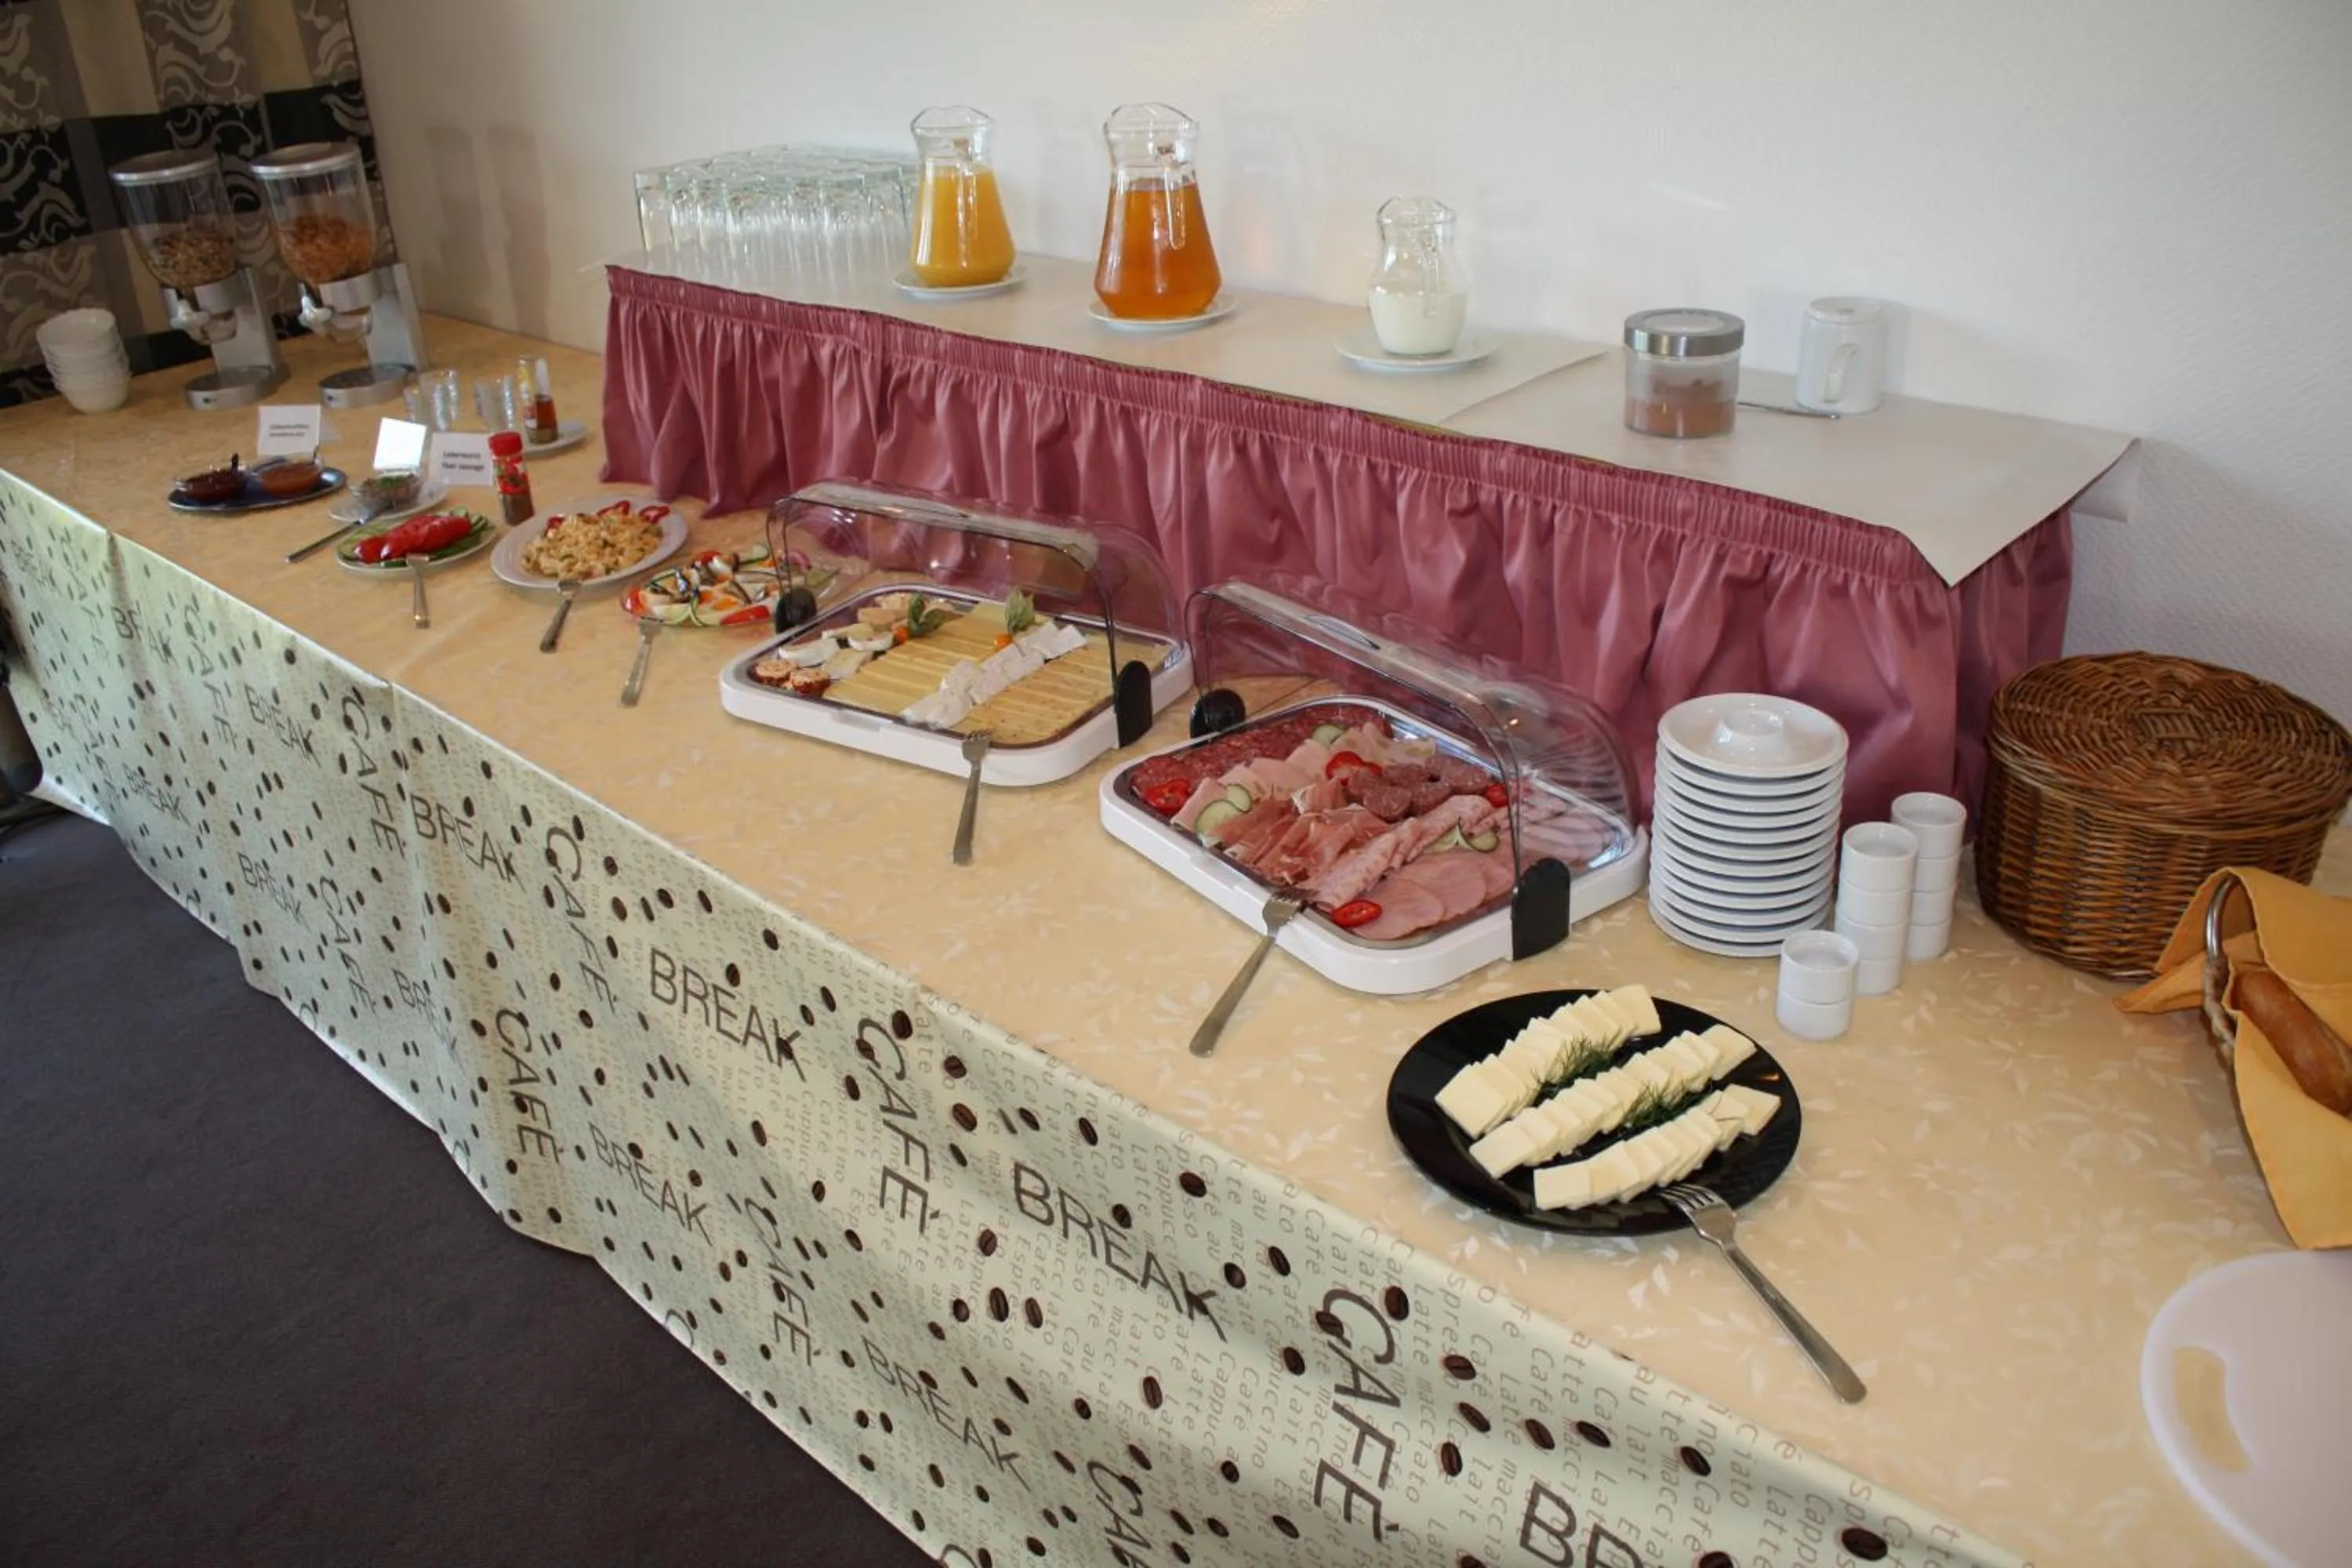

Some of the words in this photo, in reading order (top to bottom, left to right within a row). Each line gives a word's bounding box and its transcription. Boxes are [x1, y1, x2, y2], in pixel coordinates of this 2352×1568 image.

[245, 684, 321, 769] BREAK
[411, 793, 527, 892] BREAK
[650, 946, 807, 1082] BREAK
[589, 1121, 713, 1247] BREAK
[1014, 1160, 1228, 1343] BREAK
[1413, 1283, 1434, 1366] Latte
[862, 1334, 1030, 1492] BREAK
[1181, 1352, 1213, 1432] Latte
[1282, 1385, 1311, 1446] lait
[1405, 1377, 1436, 1503] macciato
[1499, 1372, 1521, 1445] Latte
